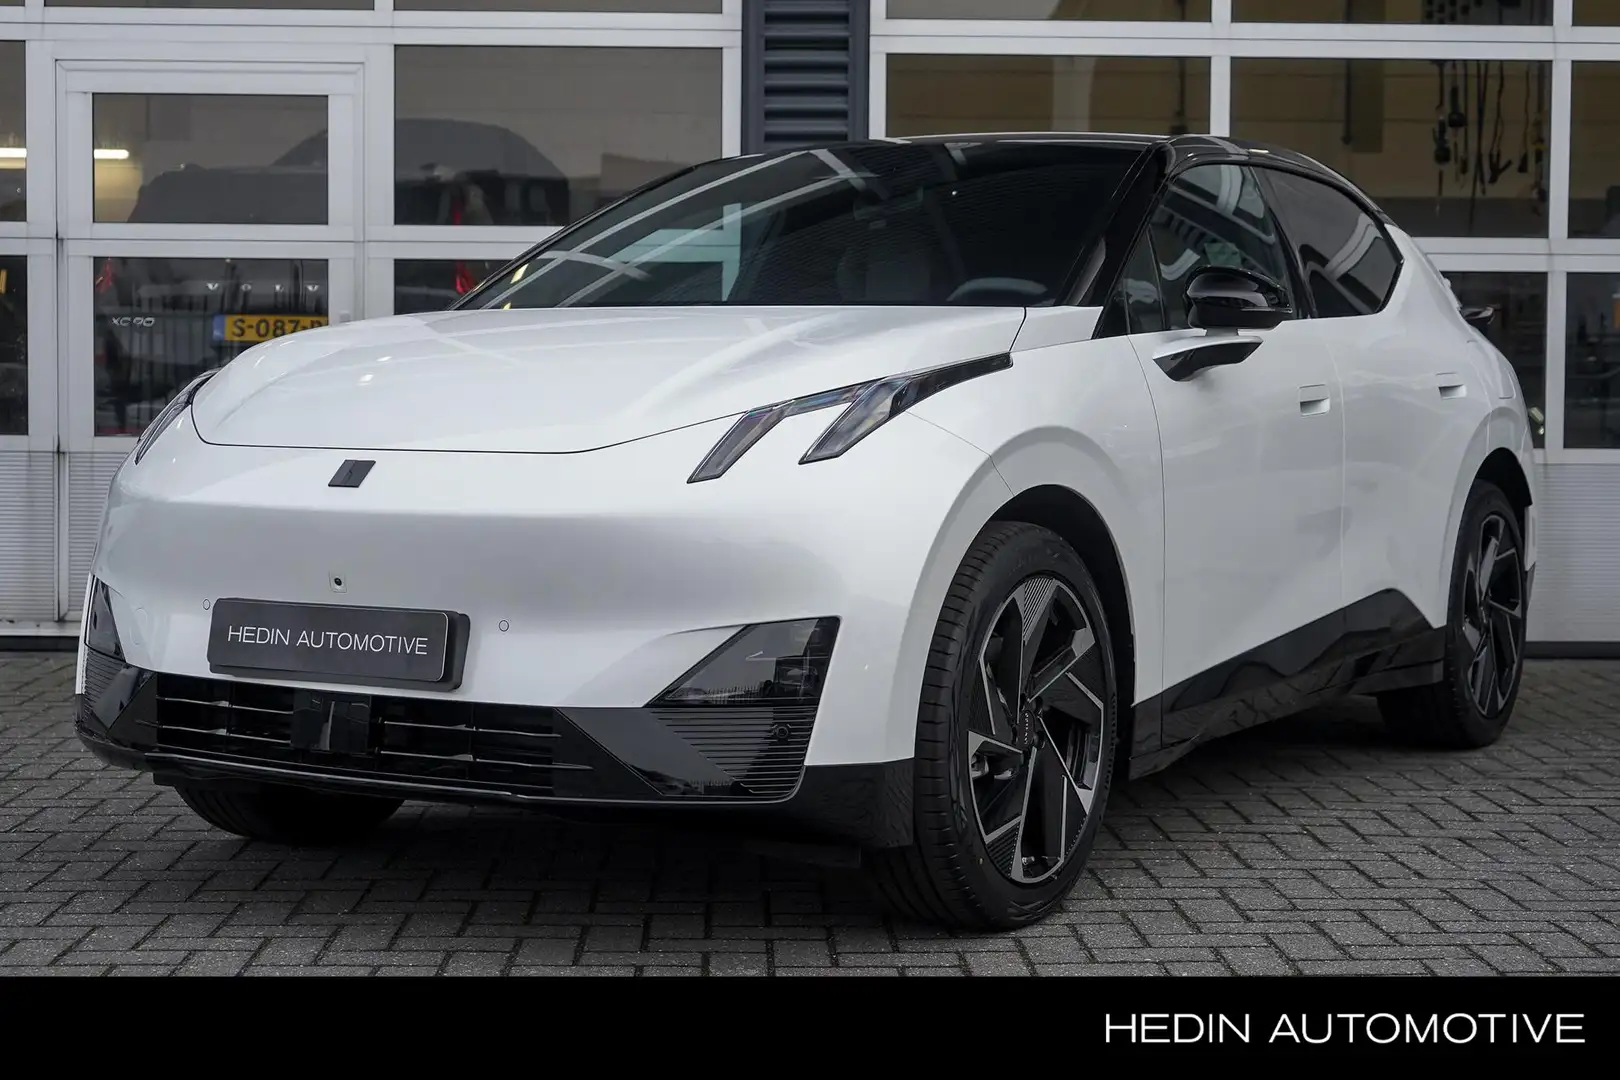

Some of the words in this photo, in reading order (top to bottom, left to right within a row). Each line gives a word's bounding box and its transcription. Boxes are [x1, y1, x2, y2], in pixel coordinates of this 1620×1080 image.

[207, 282, 320, 293] VOLV
[112, 316, 155, 328] XC90
[227, 625, 290, 646] HEDIN
[296, 630, 428, 655] AUTOMOTIVE
